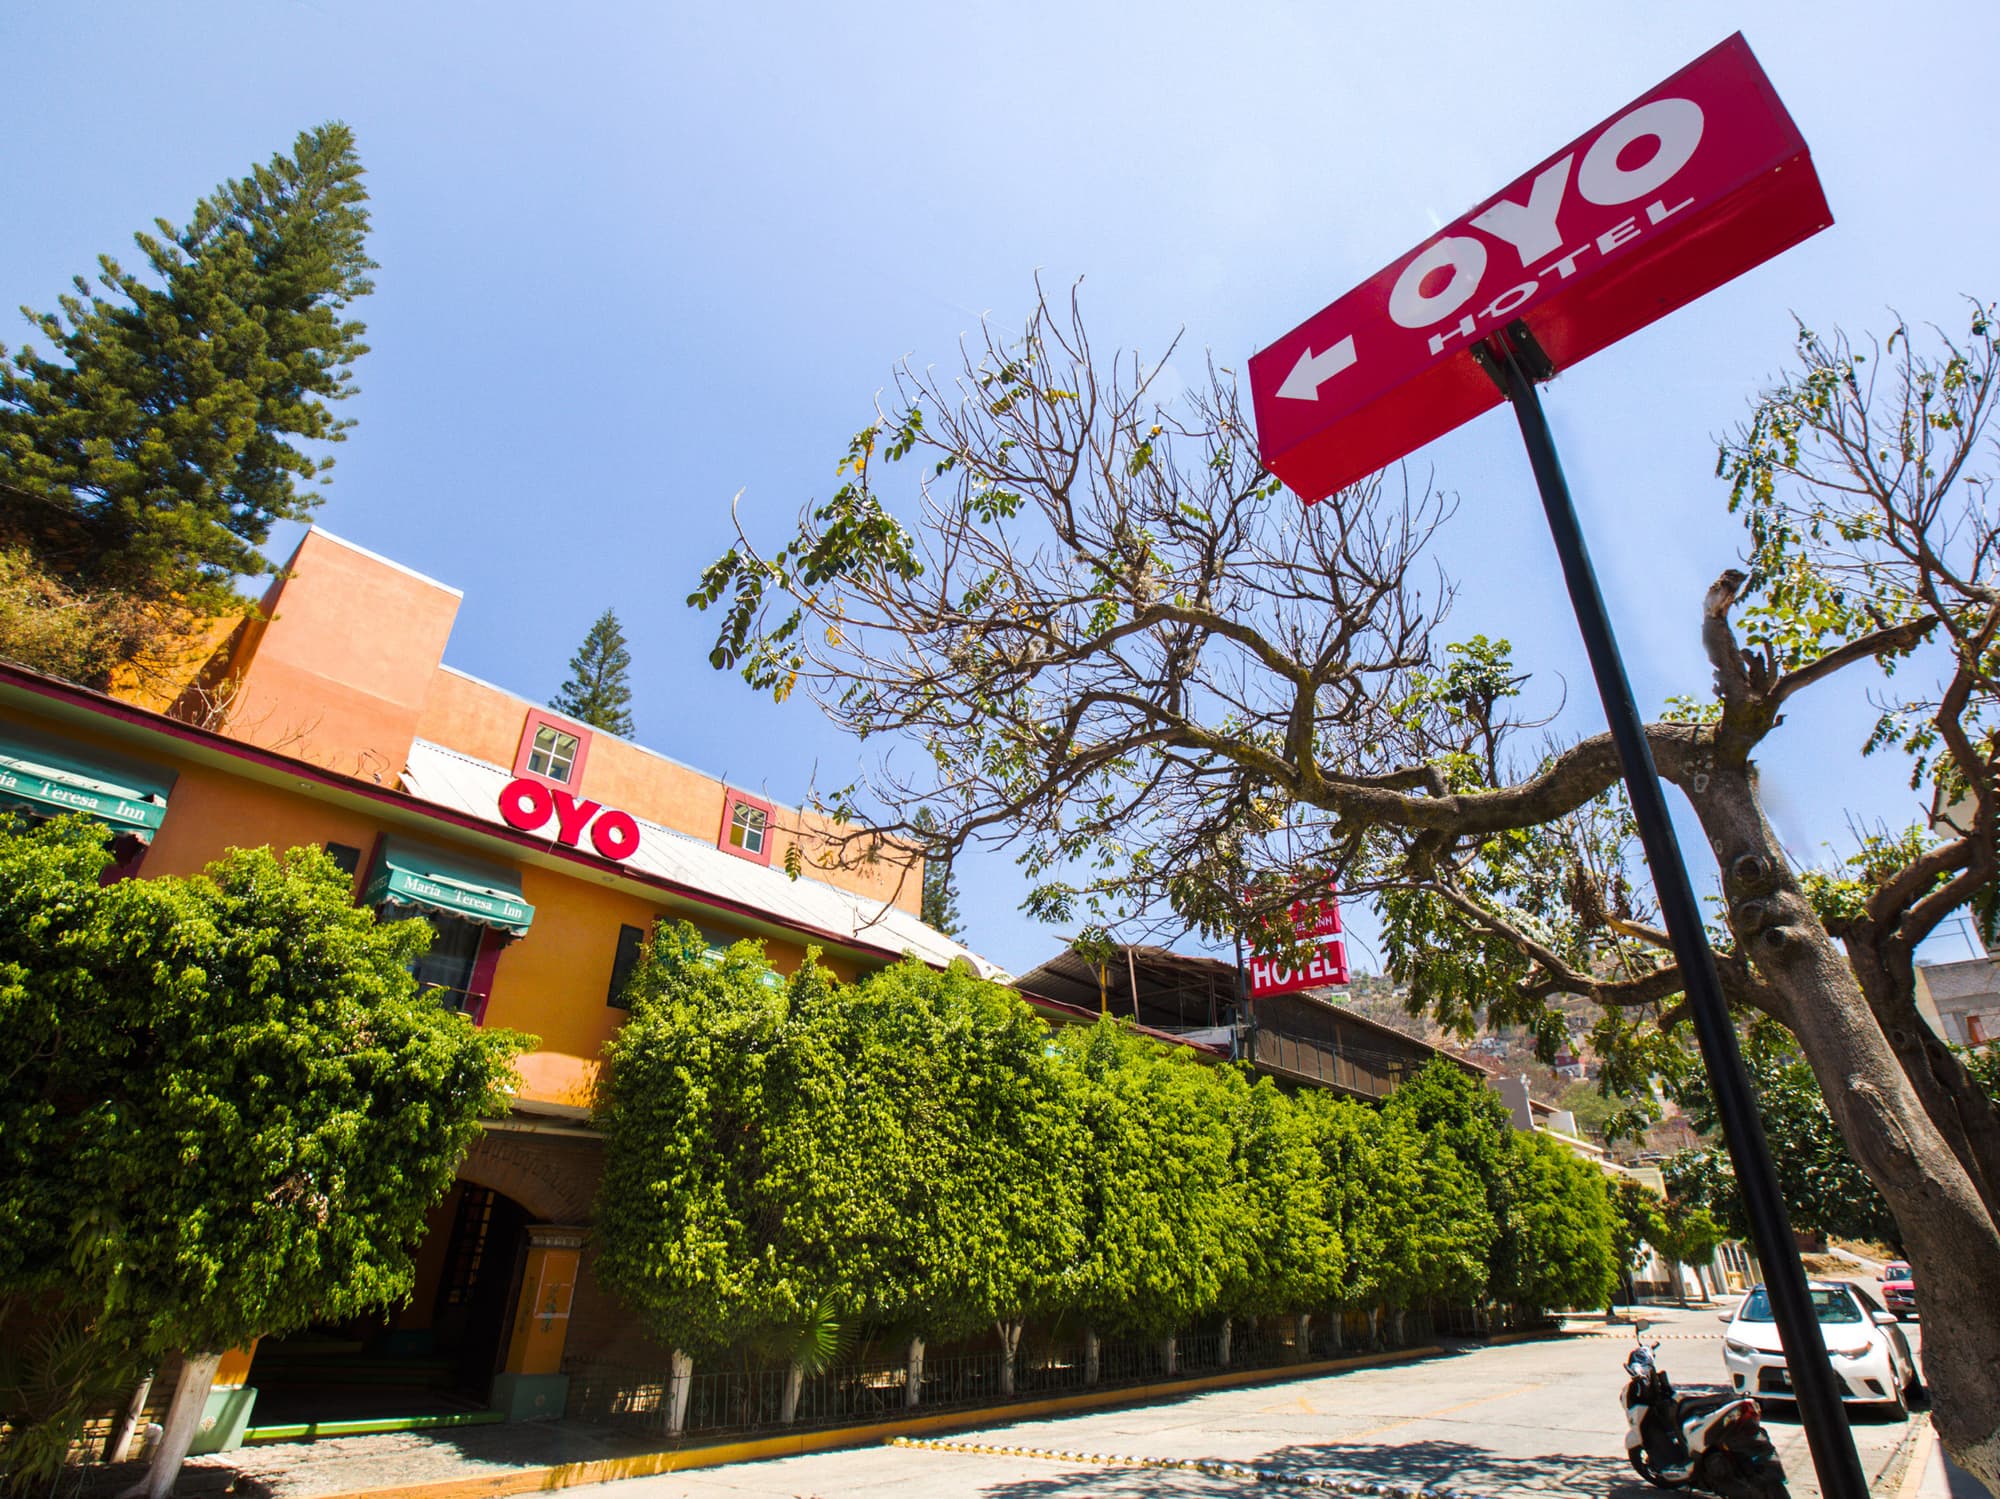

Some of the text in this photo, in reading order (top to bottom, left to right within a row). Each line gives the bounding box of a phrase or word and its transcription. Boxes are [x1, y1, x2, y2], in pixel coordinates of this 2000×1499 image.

[1388, 98, 1704, 329] OYO
[1427, 197, 1695, 356] HOTEL
[39, 779, 98, 809] Teresa
[115, 801, 145, 821] Inn
[498, 778, 640, 861] OYO
[404, 876, 441, 897] María
[454, 889, 492, 911] Teresa
[502, 903, 523, 919] Inn
